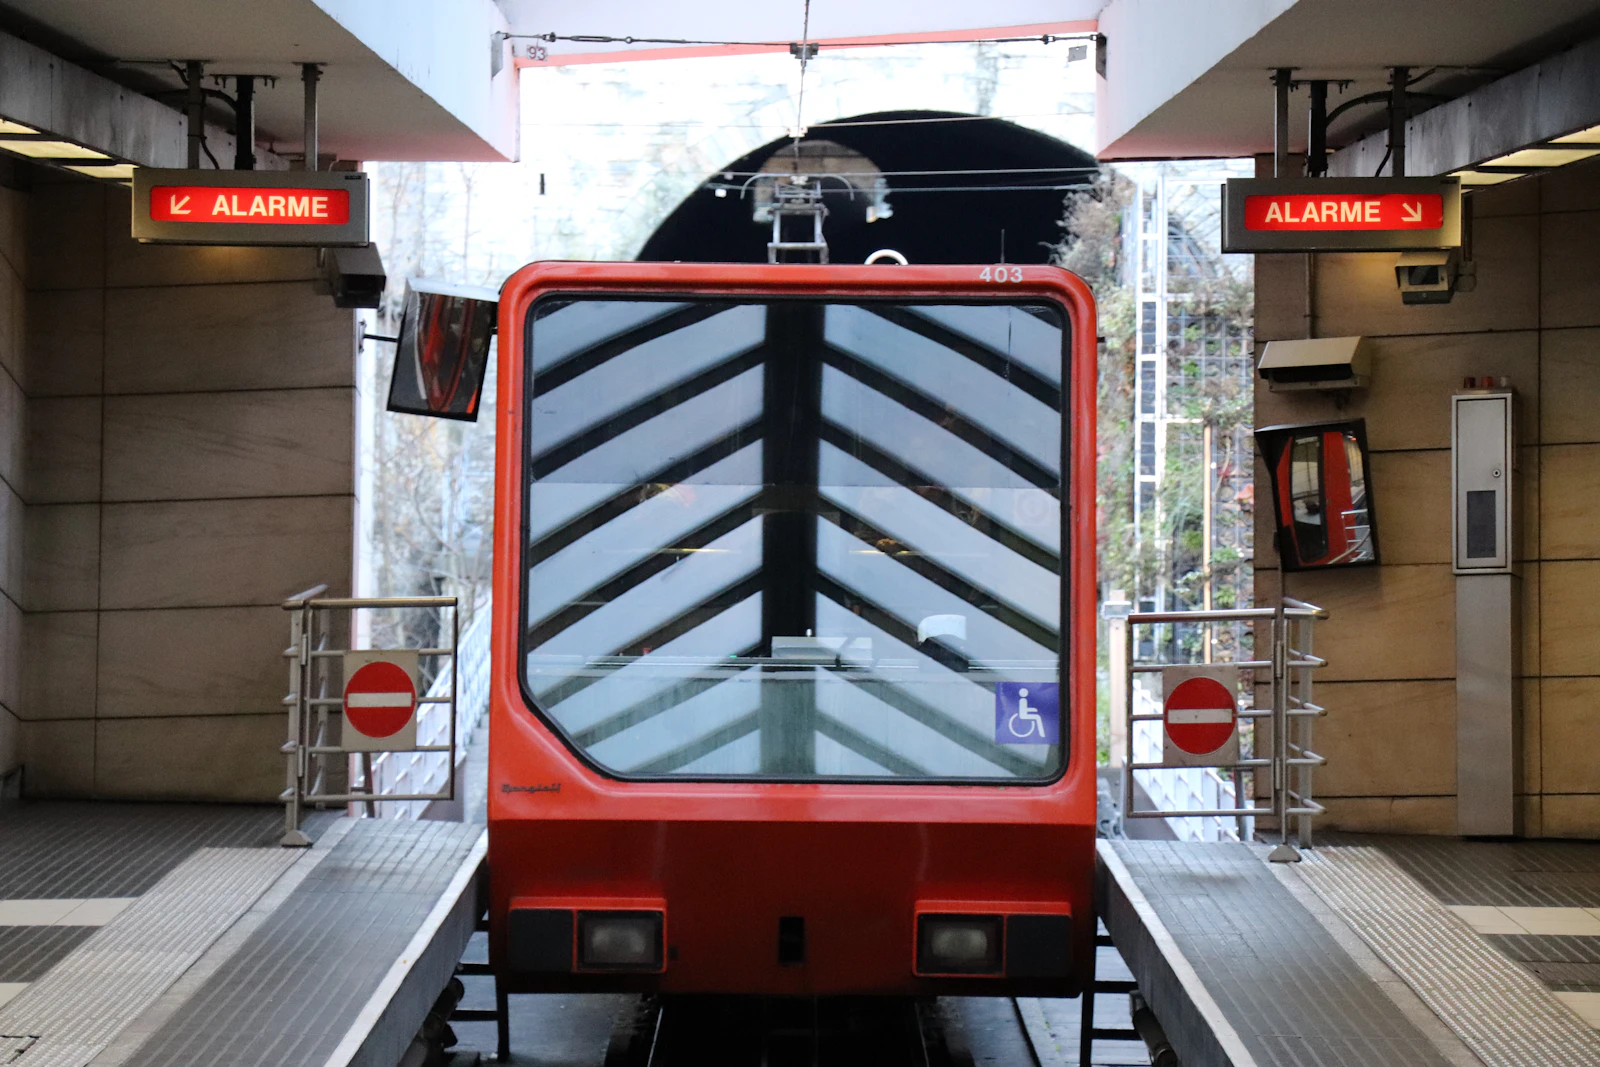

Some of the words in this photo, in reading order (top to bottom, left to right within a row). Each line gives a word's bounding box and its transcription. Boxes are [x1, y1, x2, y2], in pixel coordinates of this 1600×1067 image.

[528, 46, 546, 61] 93
[211, 194, 329, 218] ALARME
[1264, 201, 1381, 223] ALARME
[979, 266, 1023, 283] 403
